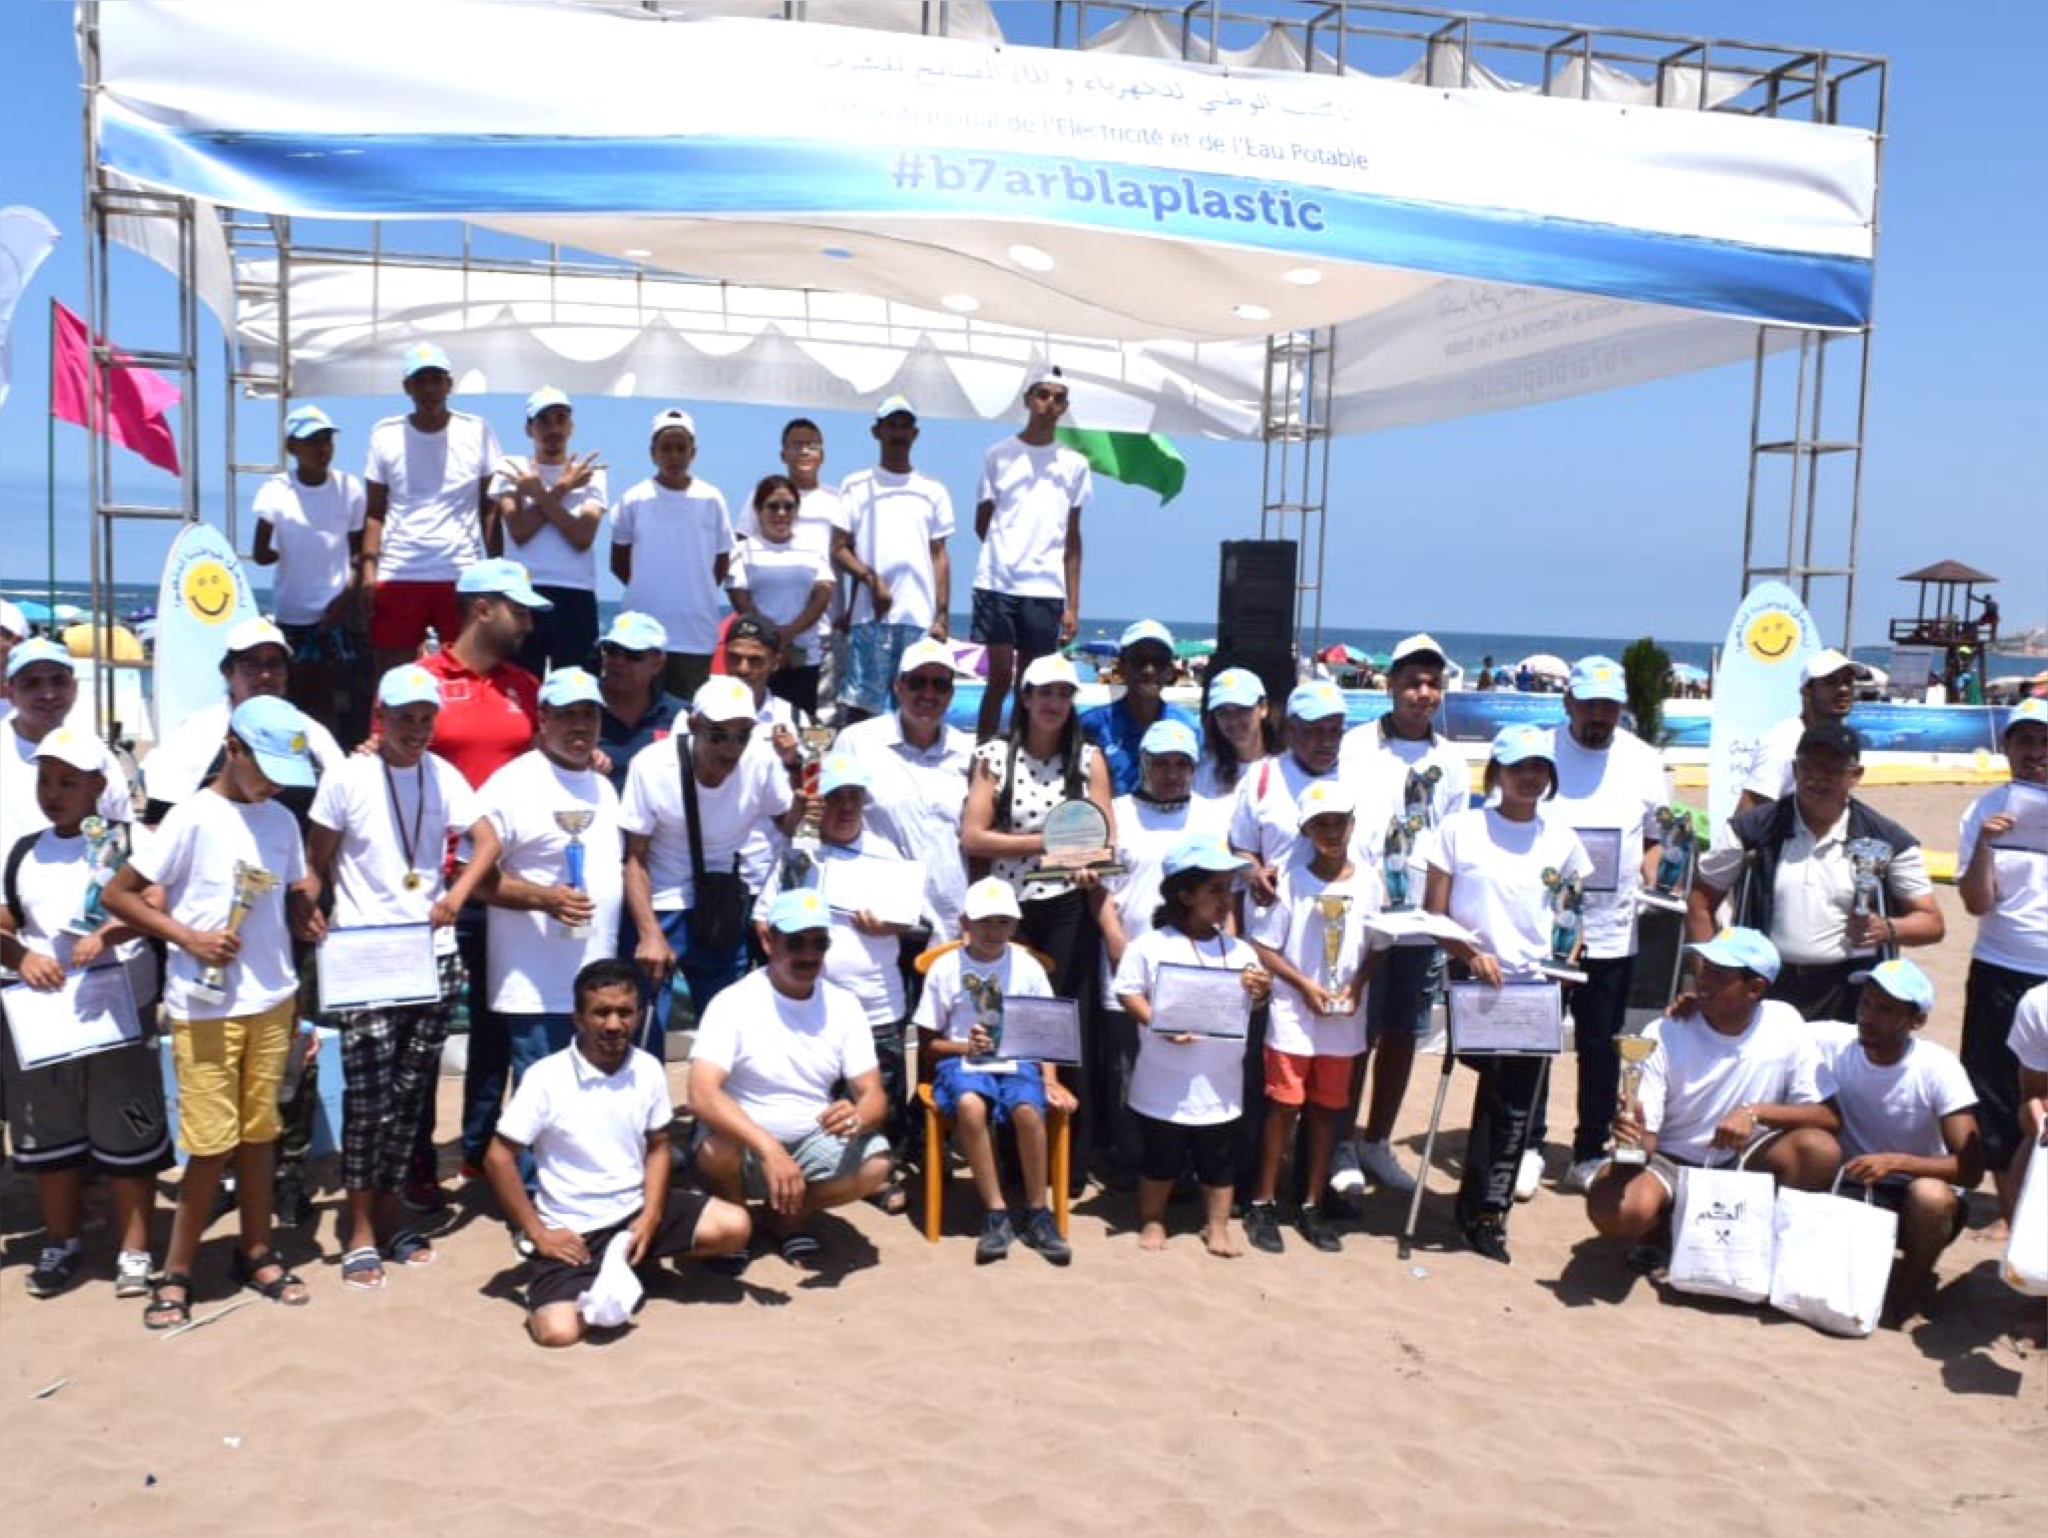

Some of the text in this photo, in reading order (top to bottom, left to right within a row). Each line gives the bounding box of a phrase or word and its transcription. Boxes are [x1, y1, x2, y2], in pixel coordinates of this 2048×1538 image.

[1170, 130, 1190, 147] et
[1199, 132, 1225, 152] de
[1233, 136, 1285, 160] l'Eau
[1291, 142, 1369, 170] Potable
[891, 149, 1325, 231] #b7arblaplastic
